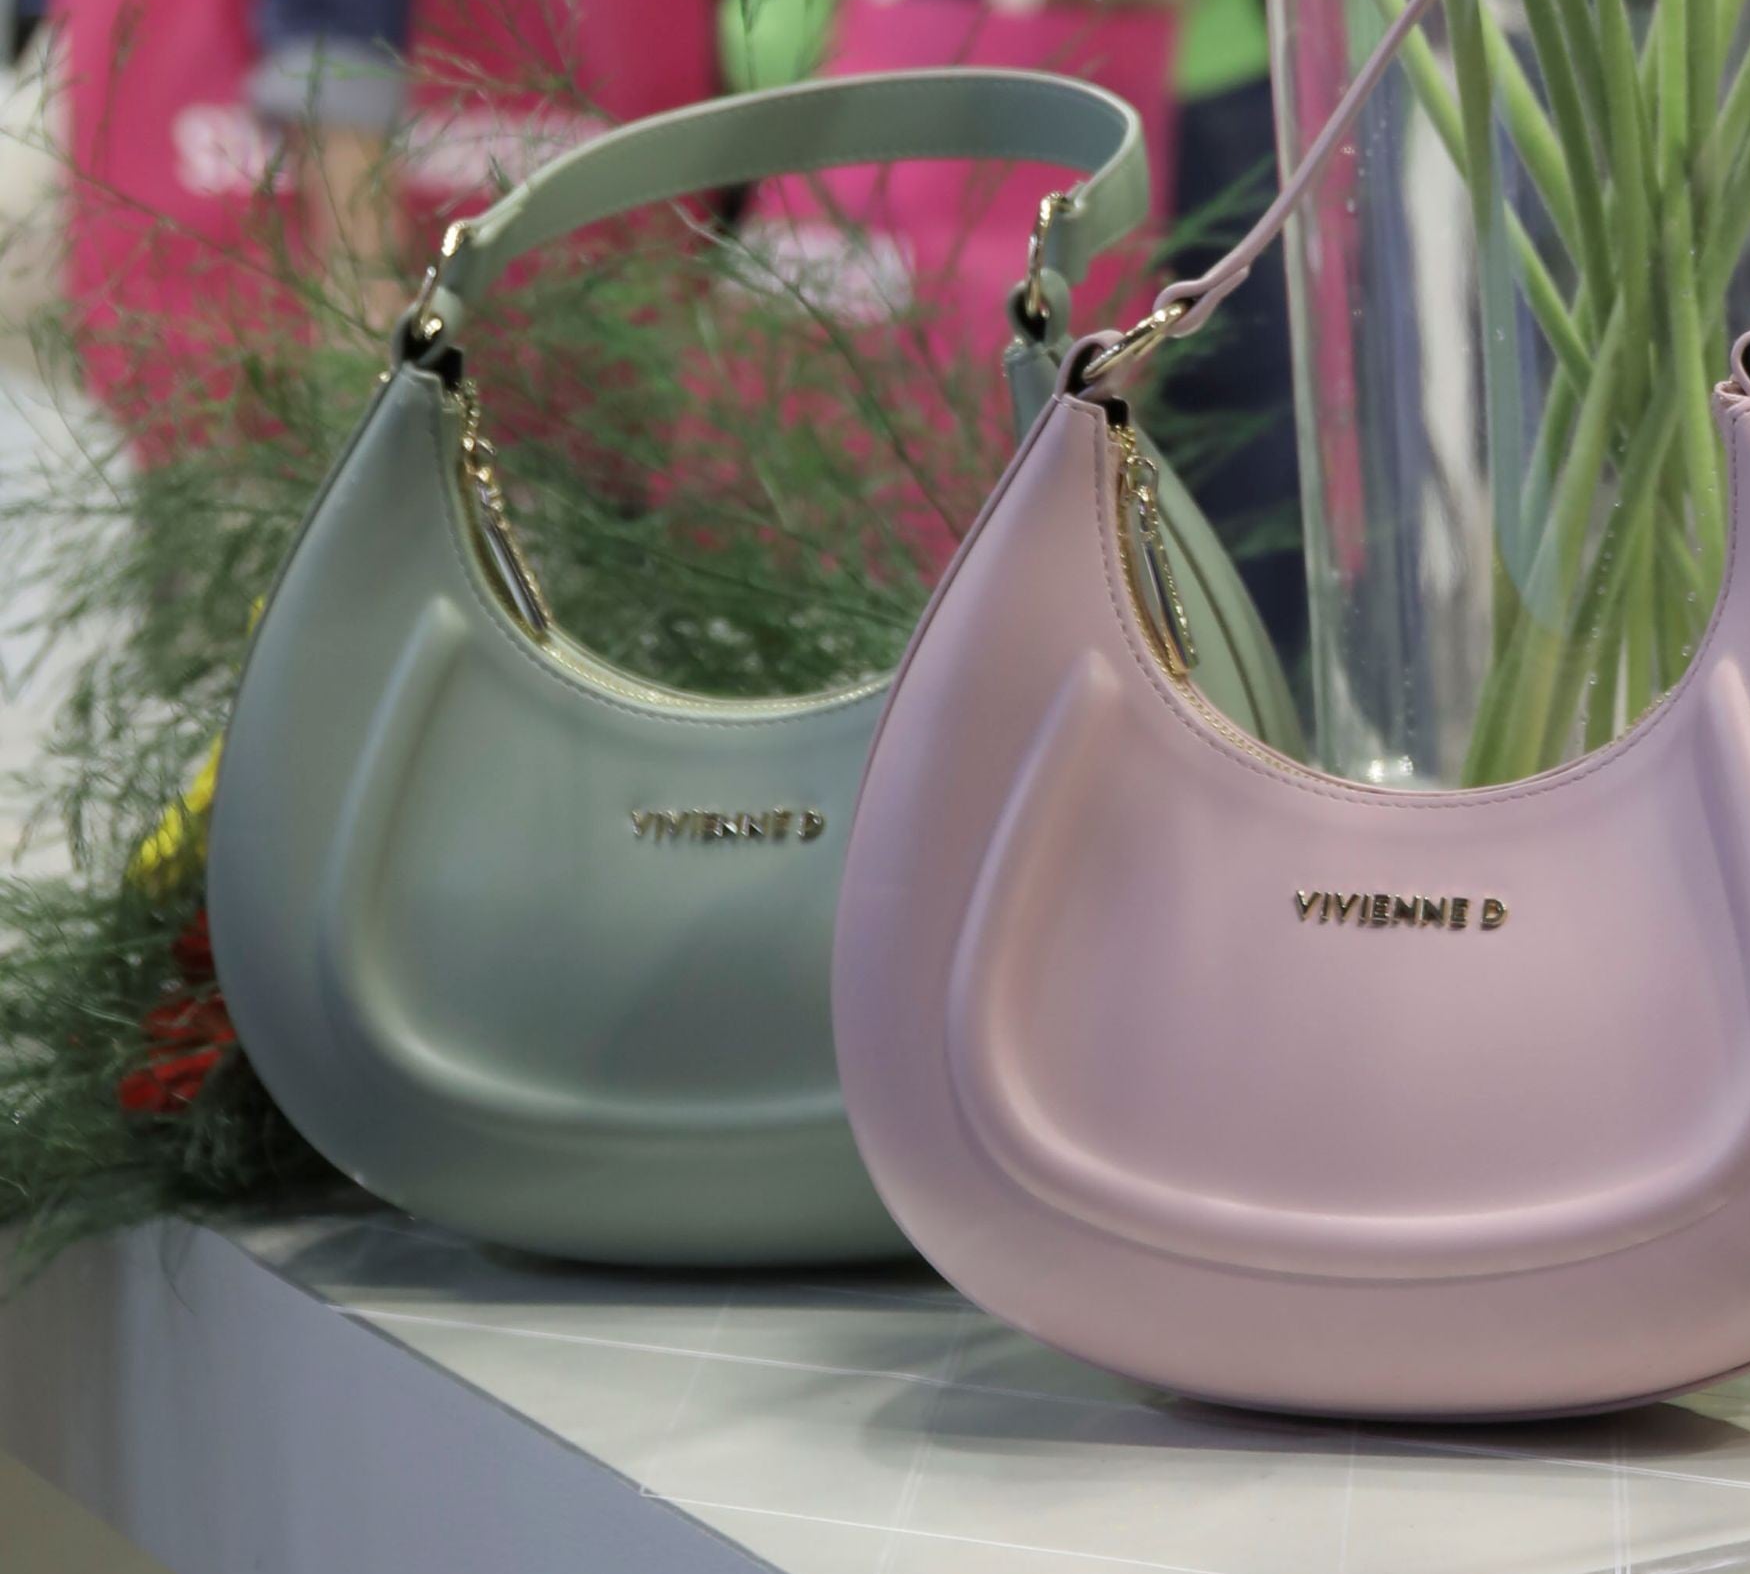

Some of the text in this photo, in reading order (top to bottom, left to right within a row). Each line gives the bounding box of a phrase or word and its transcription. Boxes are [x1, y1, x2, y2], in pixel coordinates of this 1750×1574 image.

[632, 806, 825, 844] VIVIENNE D
[1296, 890, 1508, 931] VIVIENNE D
